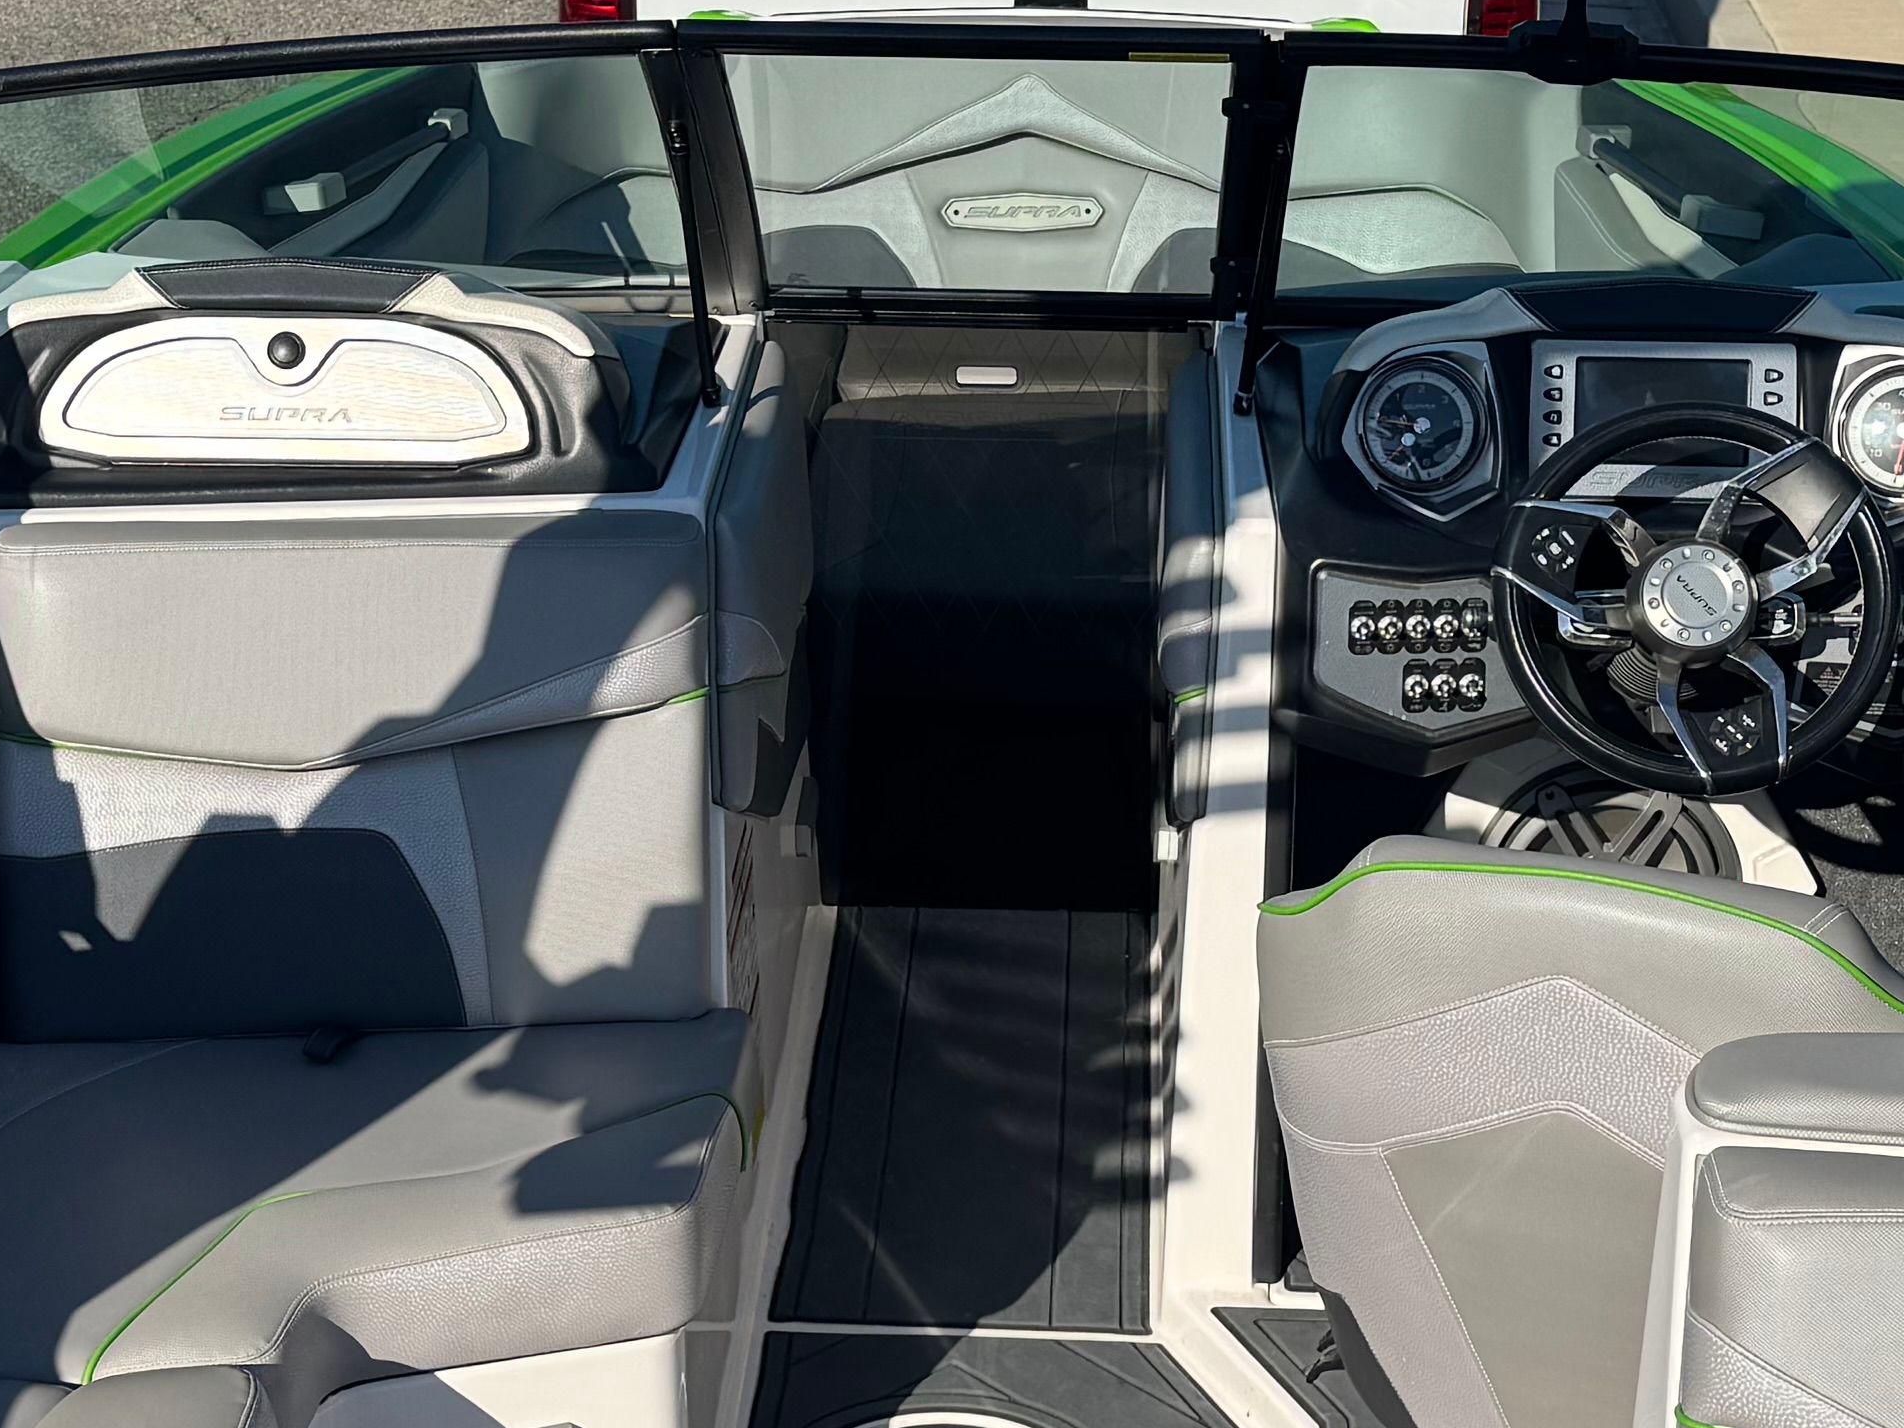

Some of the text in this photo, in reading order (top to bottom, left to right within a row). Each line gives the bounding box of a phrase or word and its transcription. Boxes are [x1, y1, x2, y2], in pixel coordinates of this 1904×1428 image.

[963, 205, 1082, 219] SUPRA
[219, 406, 353, 423] SUPRA
[1675, 574, 1718, 617] SUPRA
